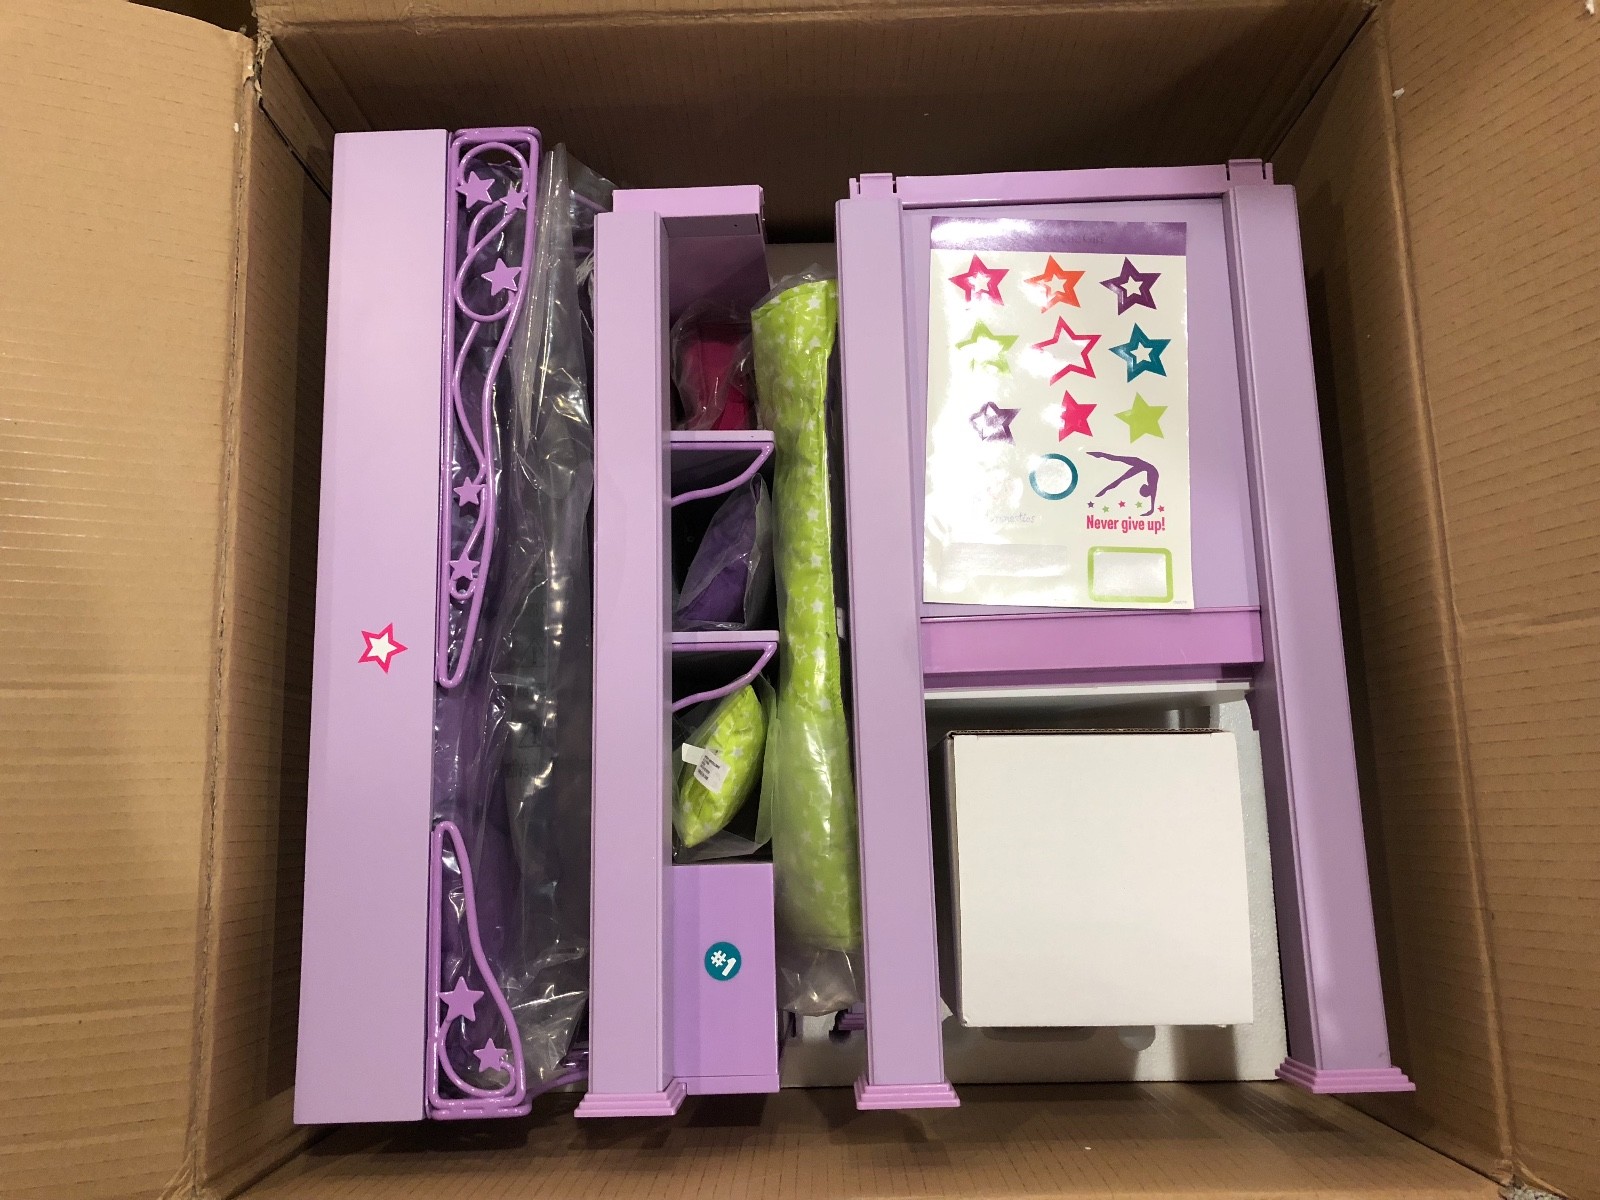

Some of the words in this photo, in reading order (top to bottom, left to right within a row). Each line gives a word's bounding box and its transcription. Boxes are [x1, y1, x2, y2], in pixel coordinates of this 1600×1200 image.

[1086, 514, 1119, 530] Never
[1121, 516, 1145, 534] give
[1147, 516, 1166, 535] up!
[710, 949, 737, 977] #1
